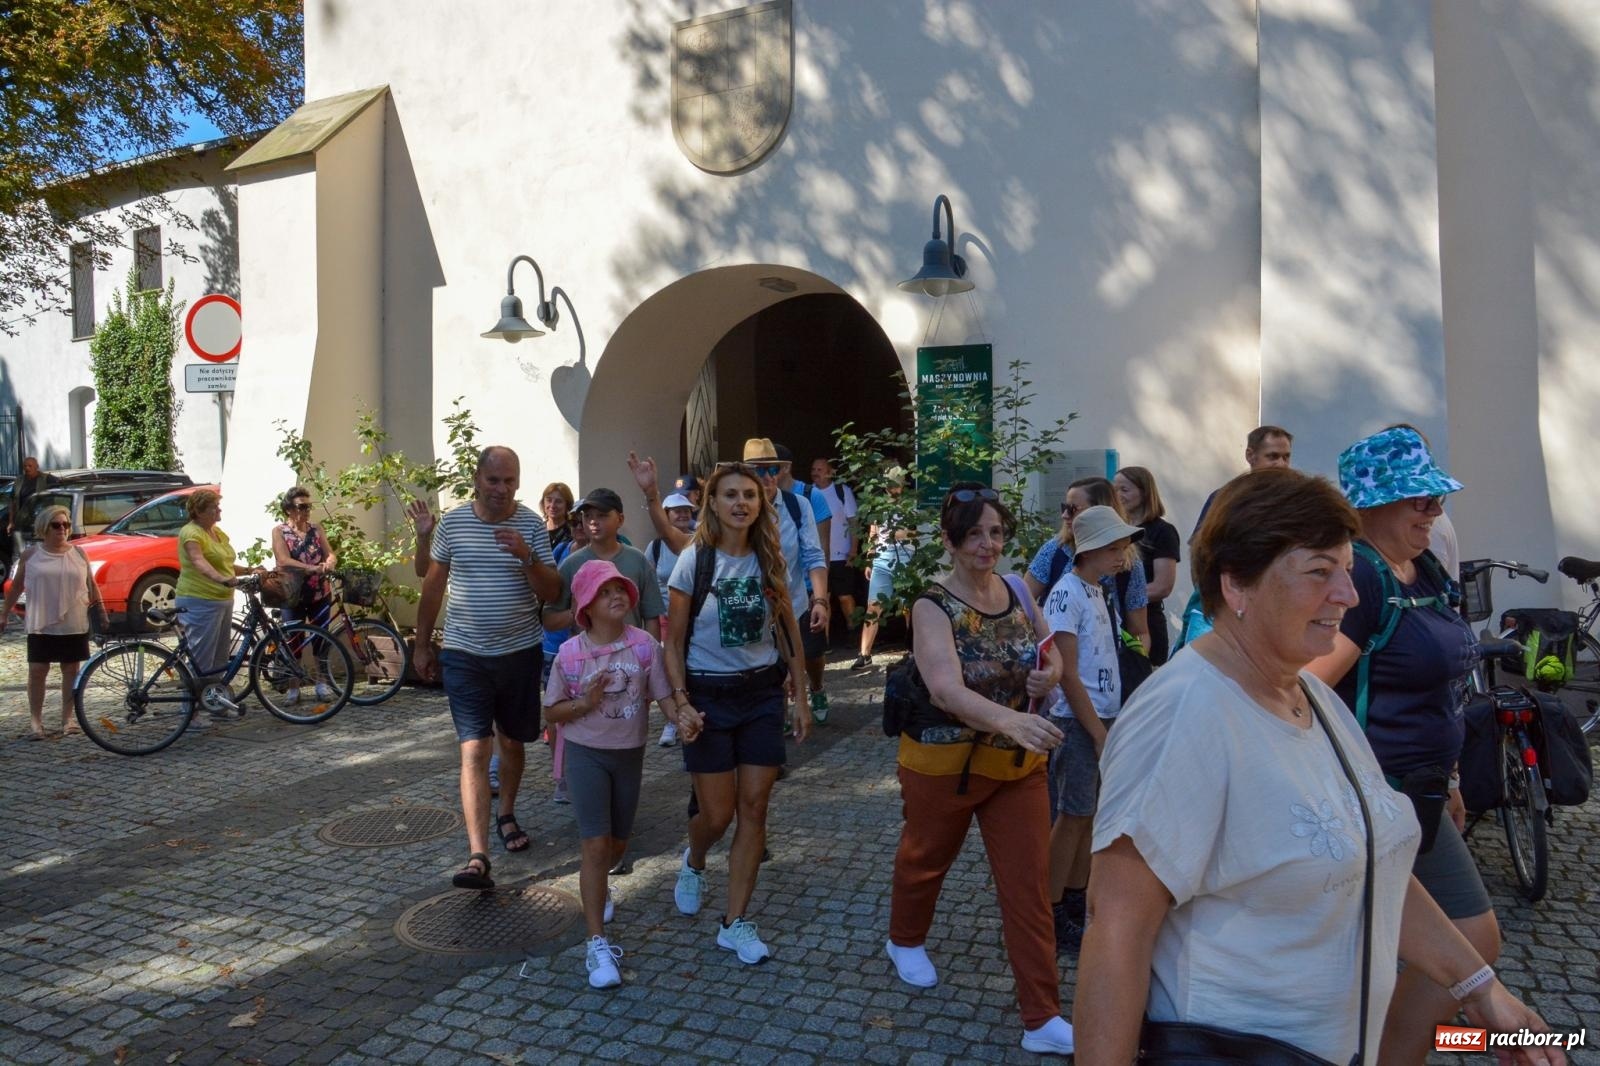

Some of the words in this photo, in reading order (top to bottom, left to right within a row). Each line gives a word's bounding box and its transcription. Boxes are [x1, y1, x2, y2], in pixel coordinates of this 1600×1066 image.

[921, 372, 988, 383] MASZYNOWNIA
[722, 594, 761, 605] RESULTS
[1049, 589, 1069, 615] EPIC
